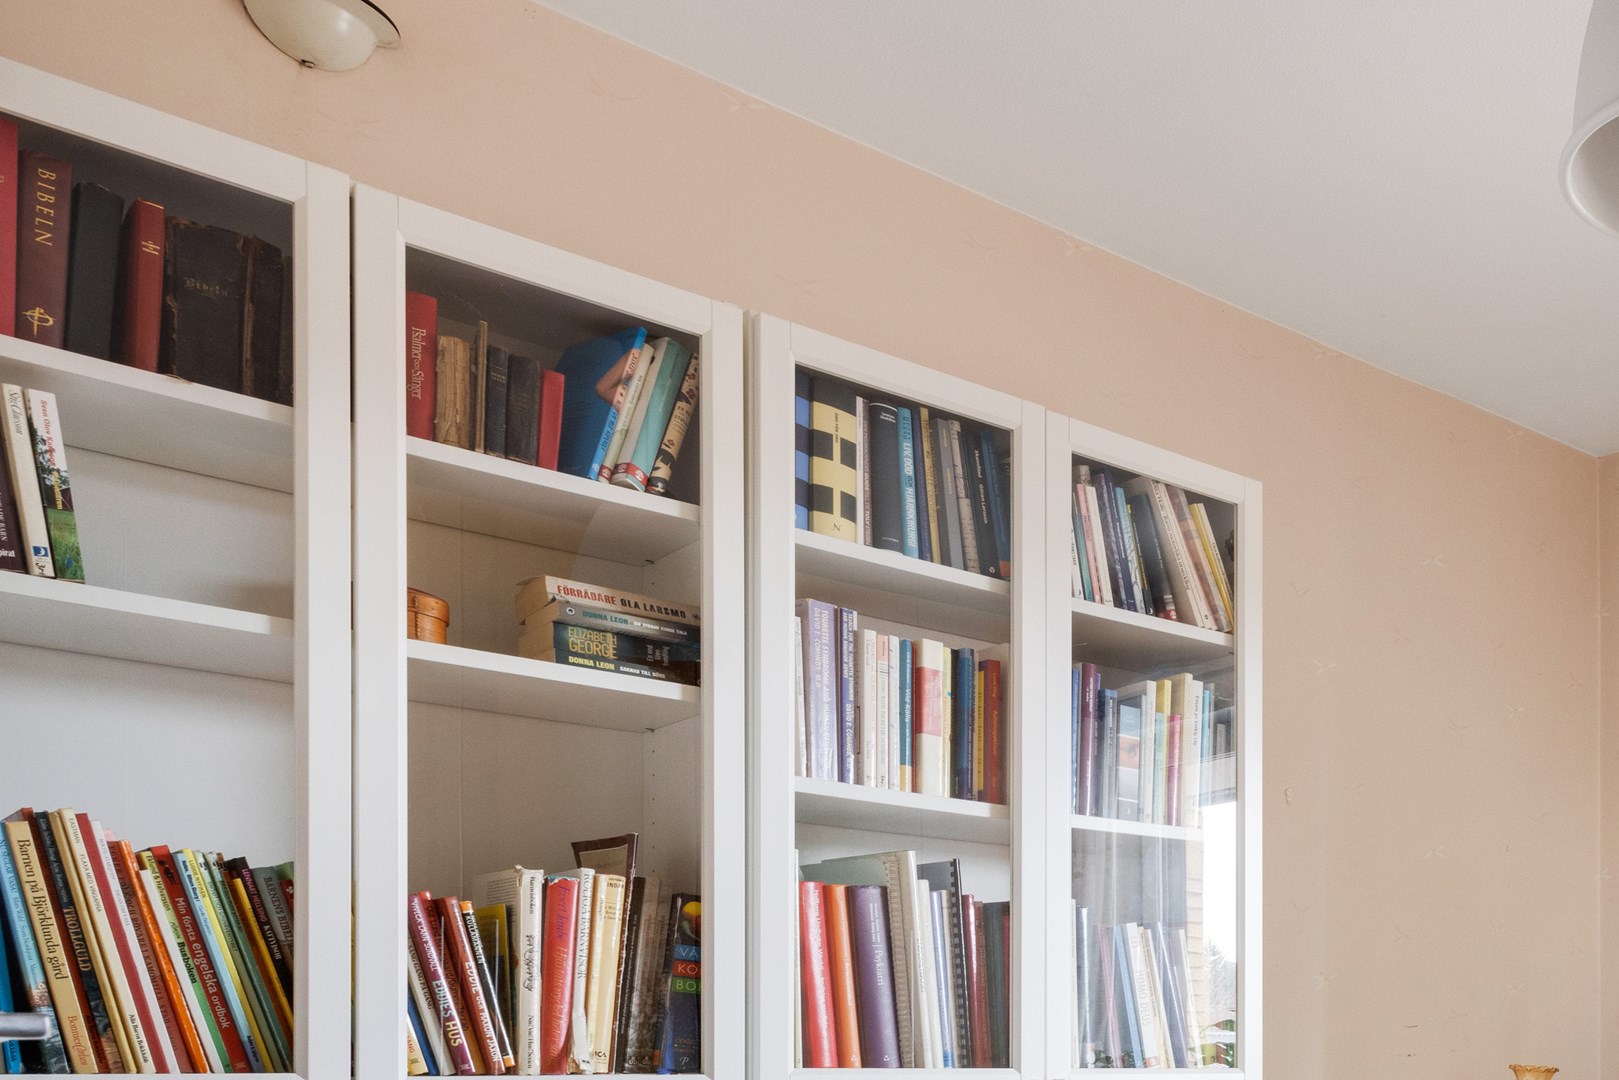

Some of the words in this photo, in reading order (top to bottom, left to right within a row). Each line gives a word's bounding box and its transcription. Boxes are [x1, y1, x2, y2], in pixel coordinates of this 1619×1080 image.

[34, 167, 56, 247] BIBELN
[411, 327, 425, 360] Psalmer
[406, 368, 423, 399] Sånger
[40, 399, 48, 417] Sven
[902, 442, 912, 457] LIV,
[903, 457, 913, 475] DÖD
[905, 487, 916, 546] HJÄRNKIRURGI
[557, 585, 617, 605] FÖRRÄDARE
[620, 598, 640, 610] OLA
[643, 603, 687, 619] LARSMO
[582, 610, 608, 621] DONNA
[610, 616, 629, 625] LEON
[820, 610, 829, 643] TOURETTE
[568, 626, 617, 645] ELIZABETH
[568, 638, 618, 659] GEORGE
[568, 656, 594, 667] DONNA
[596, 661, 615, 670] LEON
[821, 644, 829, 684] SYNDROME
[68, 817, 80, 843] EASTMAN
[17, 839, 34, 876] Barnen
[25, 880, 43, 892] på
[85, 872, 94, 884] MED
[89, 885, 102, 912] VINGARNA
[125, 901, 136, 914] OCH
[241, 868, 257, 894] LENNART
[252, 895, 267, 922] HELLSING
[263, 877, 284, 914] BARNENS
[277, 916, 294, 940] BIBEL
[580, 873, 592, 915] ROLIGA
[32, 896, 58, 952] Björklunda
[63, 908, 91, 971] TROLLGULD
[462, 916, 485, 963] KULLAMANNEN
[576, 916, 589, 978] BARNVISOR
[680, 946, 699, 959] VÅ
[47, 956, 69, 980] gård
[175, 897, 187, 913] Min
[182, 915, 196, 940] första
[191, 944, 219, 992] engelska
[211, 995, 230, 1027] ordbok
[177, 942, 198, 983] Busboken
[465, 962, 482, 992] EDDIE
[678, 963, 698, 975] KO
[873, 950, 885, 985] Psykiatri
[676, 980, 697, 991] BO
[432, 981, 455, 1016] EDDIES
[444, 1022, 465, 1046] HUS
[479, 1012, 494, 1036] MAXON
[1138, 1002, 1152, 1026] DEUS
[486, 1038, 501, 1061] JAXON
